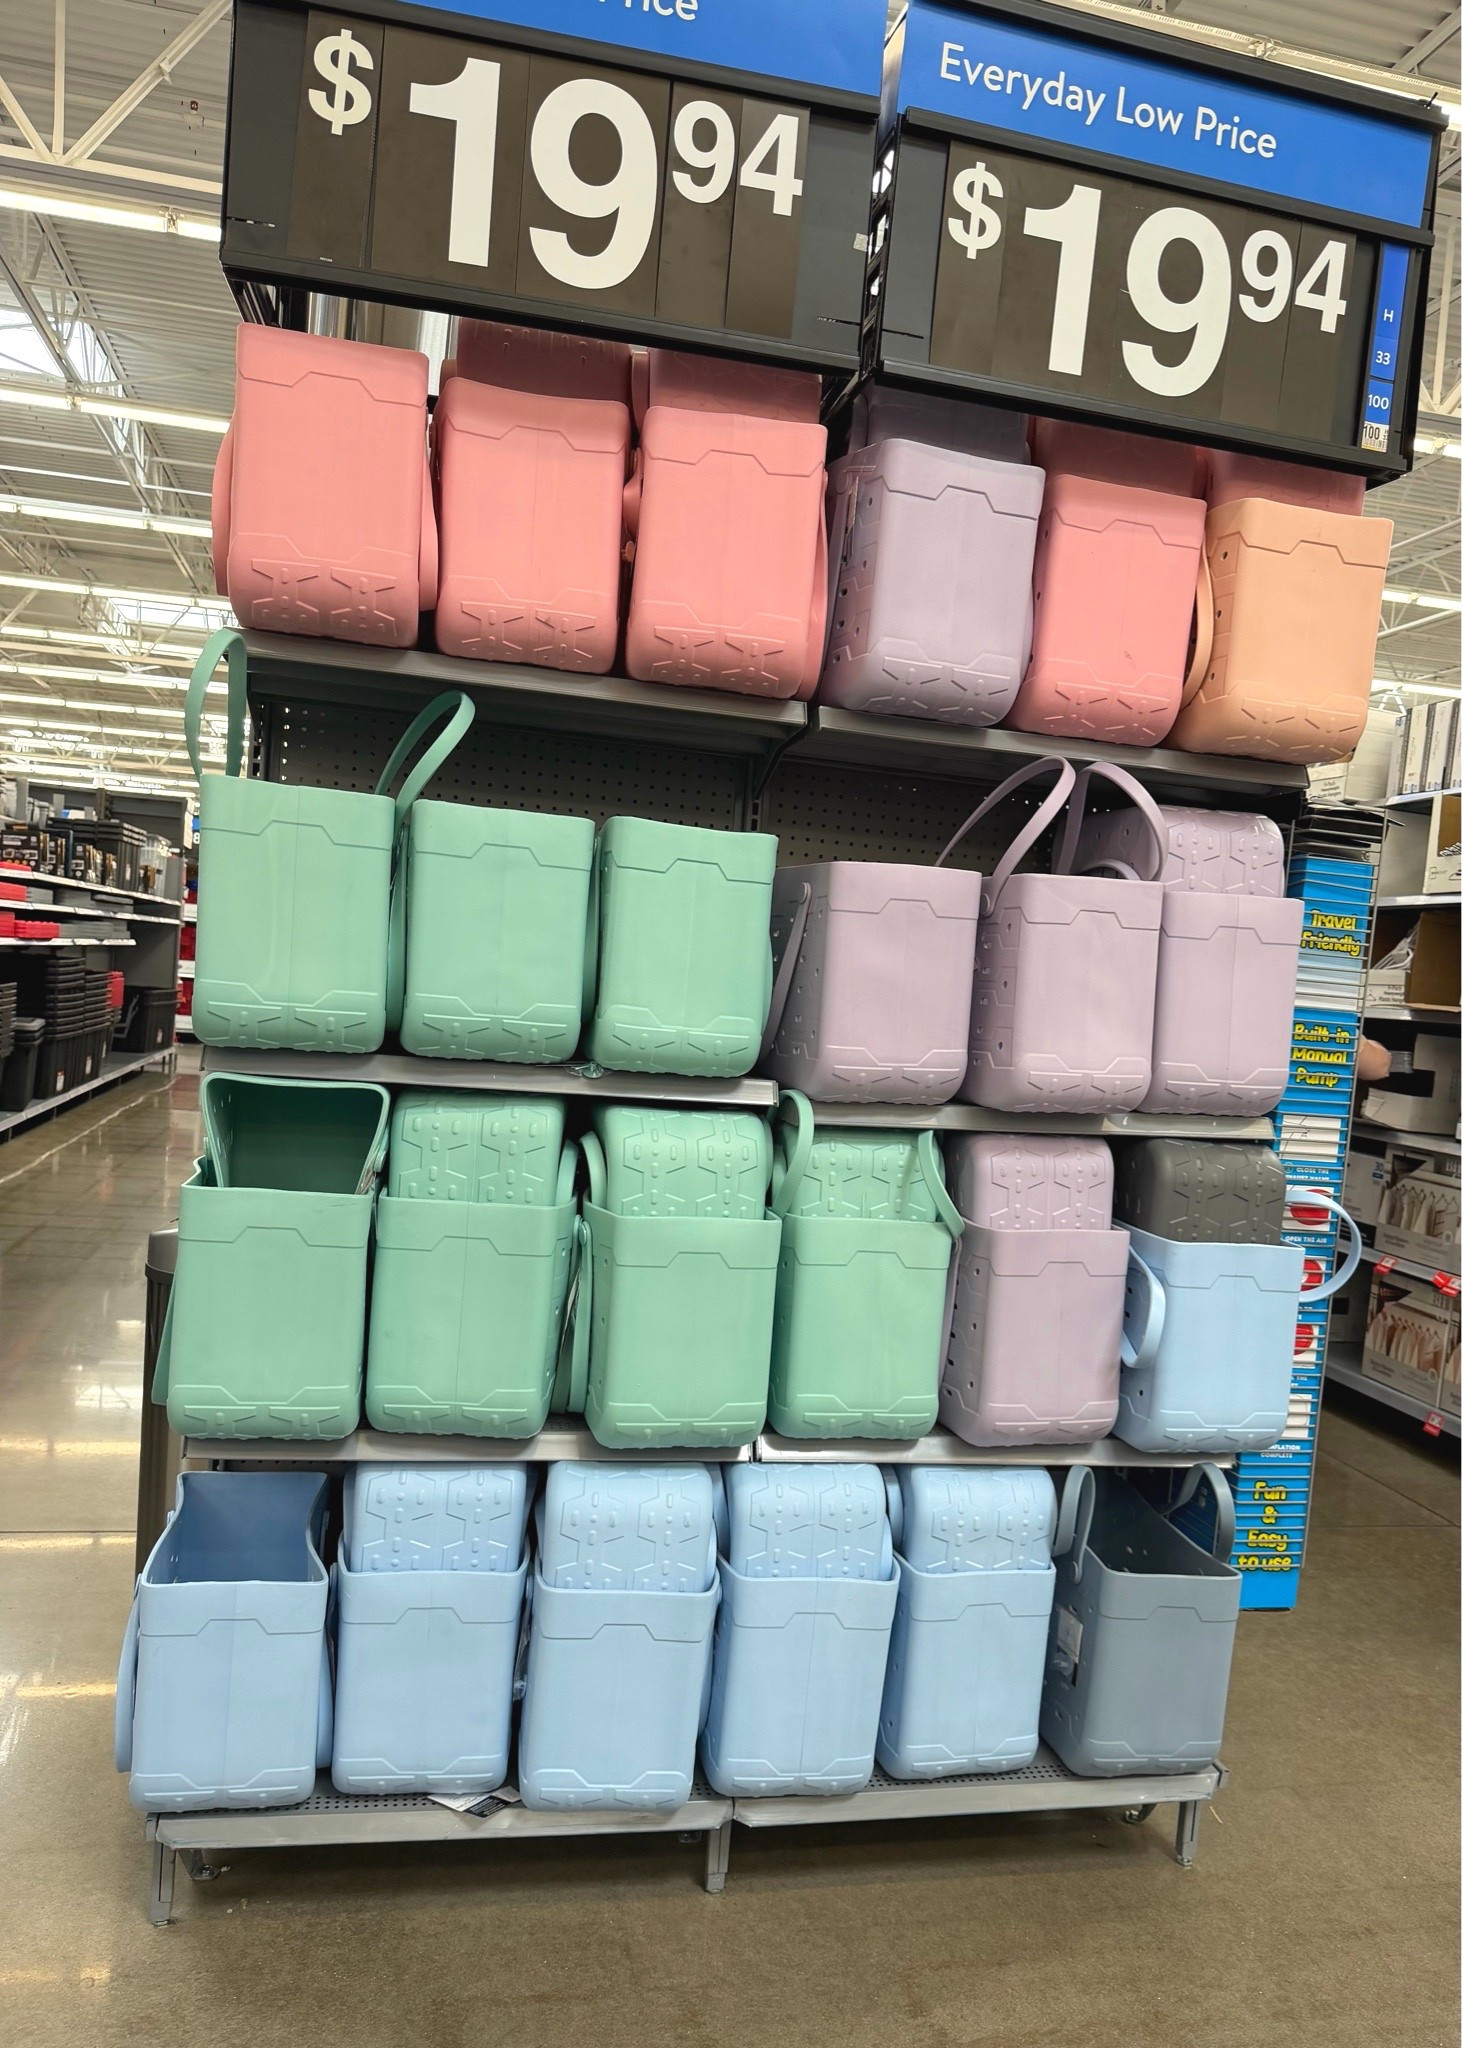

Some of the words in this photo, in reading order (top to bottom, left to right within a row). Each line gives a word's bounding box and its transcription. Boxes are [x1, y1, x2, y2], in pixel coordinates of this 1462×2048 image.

[940, 42, 1106, 126] Everyday
[1116, 86, 1184, 136] Low
[1195, 106, 1277, 158] Price
[1383, 308, 1394, 322] H
[1375, 351, 1391, 365] 33
[1368, 394, 1389, 410] 100
[1364, 425, 1380, 440] 100
[1311, 909, 1357, 930] Travel
[1301, 930, 1361, 957] Friendly
[1294, 1023, 1350, 1044] Built-in
[1292, 1047, 1347, 1065] Manual
[1296, 1065, 1339, 1088] Pump
[1253, 1480, 1287, 1501] Fun
[1262, 1504, 1278, 1524] &
[1247, 1529, 1288, 1552] Easy
[1238, 1555, 1259, 1571] to
[1261, 1556, 1292, 1572] use
